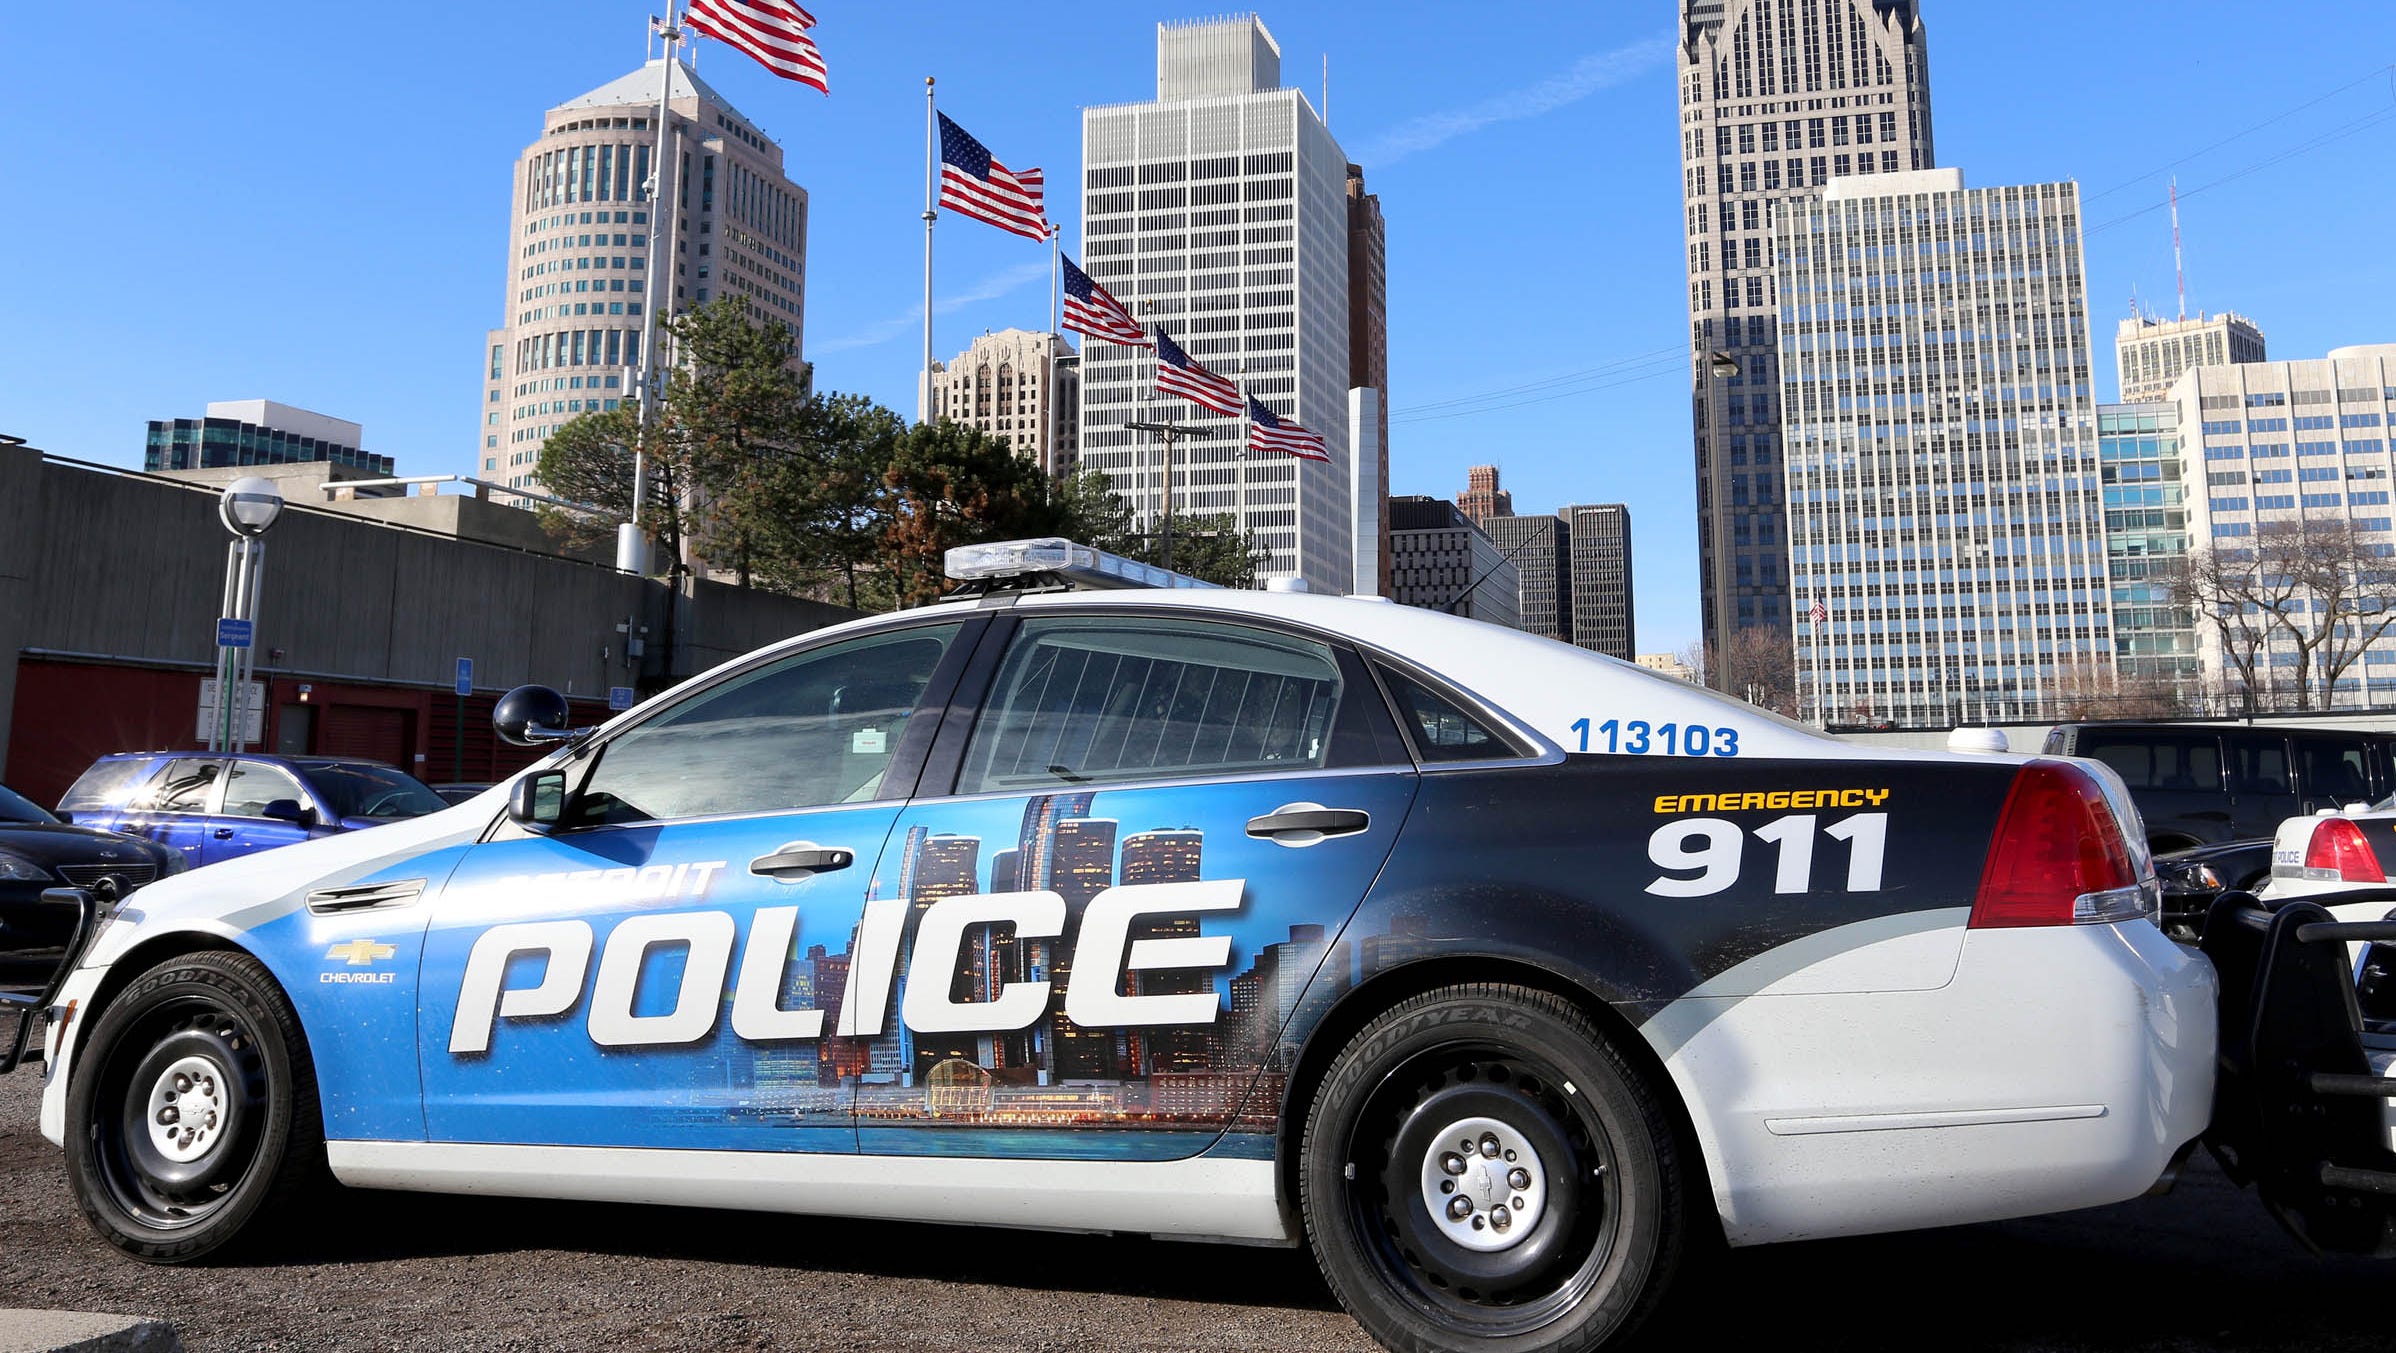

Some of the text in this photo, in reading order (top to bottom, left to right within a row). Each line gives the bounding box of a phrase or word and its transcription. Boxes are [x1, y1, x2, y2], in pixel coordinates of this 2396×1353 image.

[1570, 717, 1739, 757] 113103
[1653, 788, 1890, 813] EMERGENCY
[1643, 812, 1889, 898] 911
[2278, 851, 2300, 864] POLICE
[493, 860, 728, 911] ROIT
[319, 972, 396, 984] CHEVROLET
[447, 878, 1246, 1054] POLICE
[1332, 1007, 1533, 1110] GOODYEAR
